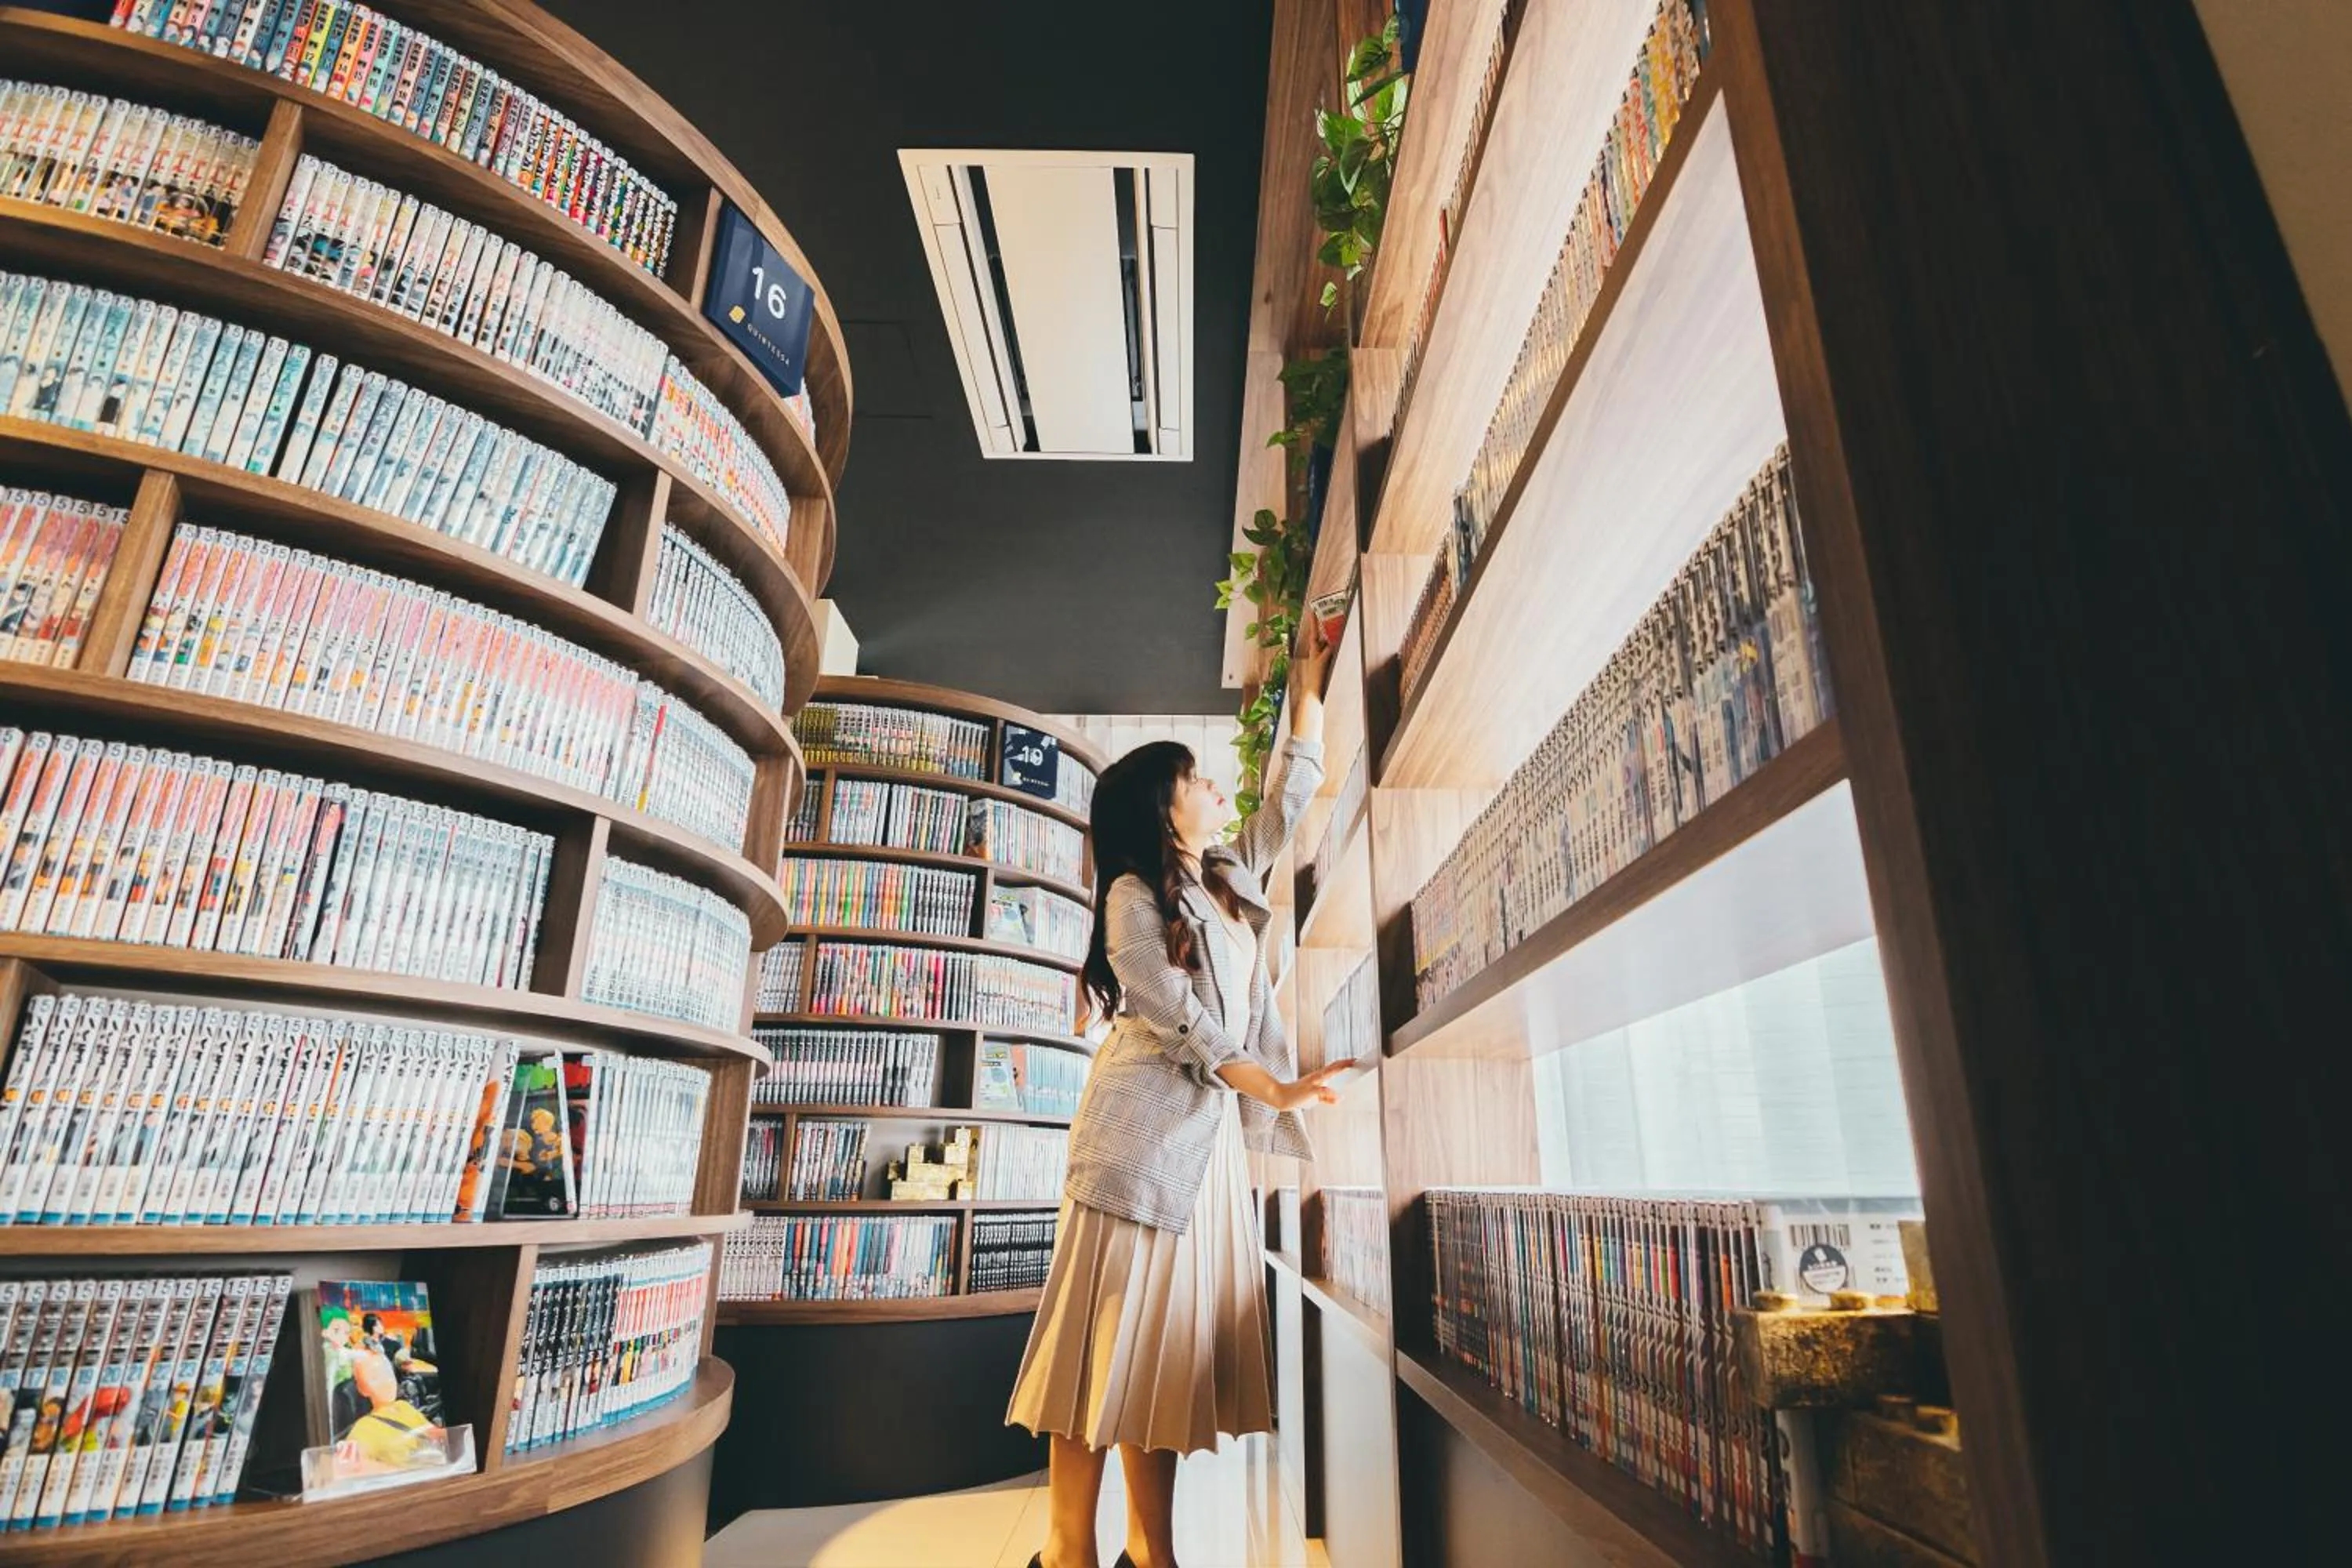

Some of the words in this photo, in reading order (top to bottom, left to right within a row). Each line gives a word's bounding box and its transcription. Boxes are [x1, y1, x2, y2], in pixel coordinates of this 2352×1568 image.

[753, 267, 787, 319] 16
[71, 503, 88, 514] 15
[91, 506, 107, 517] 15
[114, 510, 131, 524] 15
